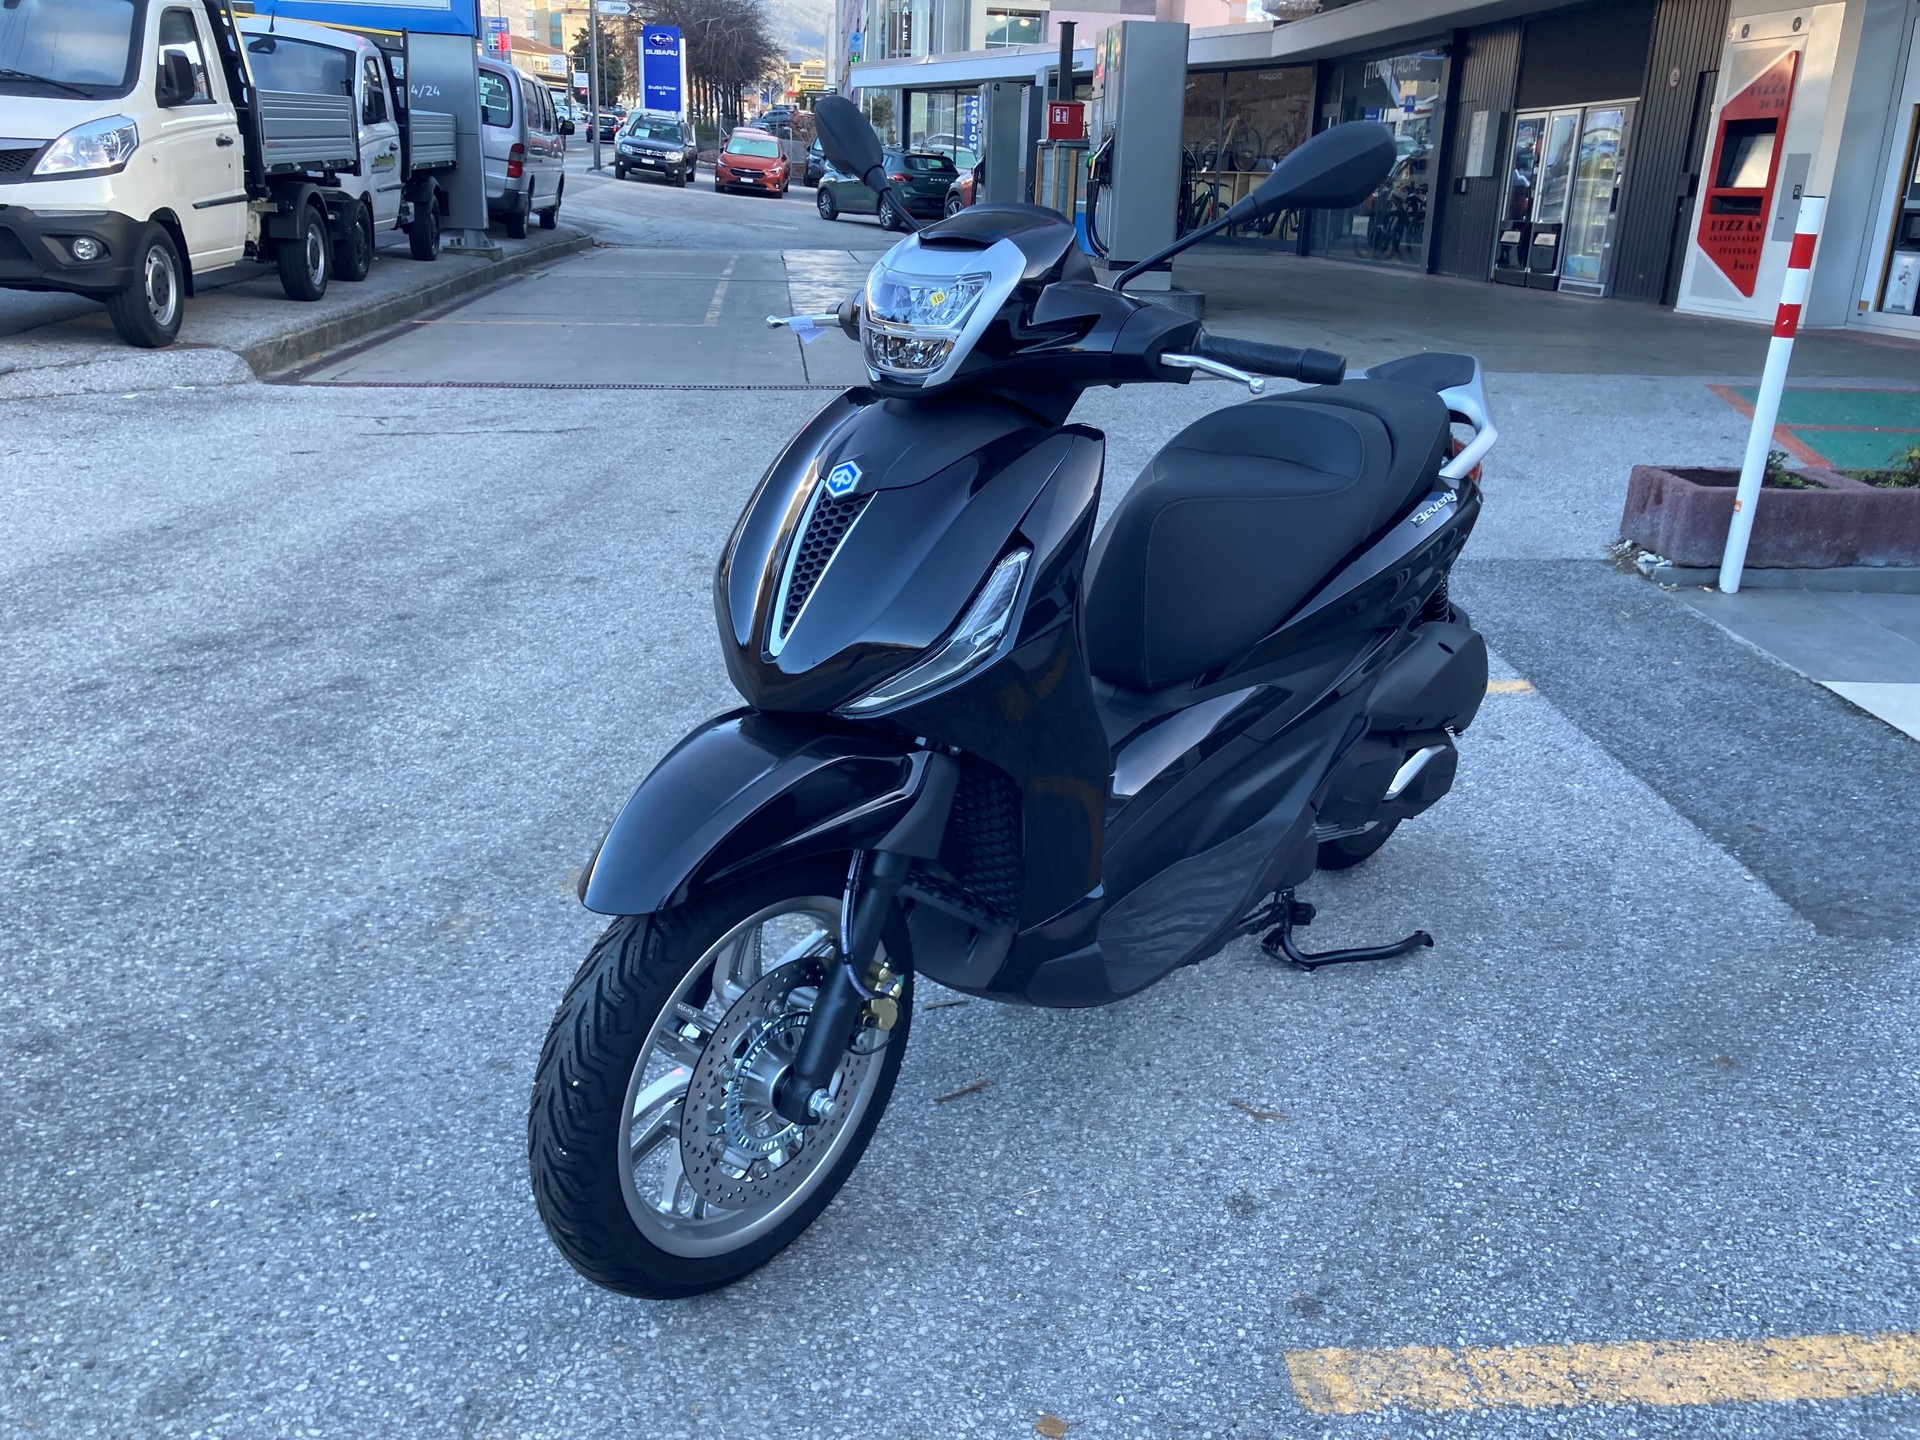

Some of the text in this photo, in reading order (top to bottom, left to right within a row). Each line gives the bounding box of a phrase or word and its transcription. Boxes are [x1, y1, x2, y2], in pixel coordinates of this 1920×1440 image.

[1258, 72, 1283, 80] PIAGGIO
[993, 83, 1000, 92] 4
[1750, 84, 1786, 96] PIZZA
[1710, 220, 1762, 231] PIZZAS
[1410, 489, 1458, 524] Beverly
